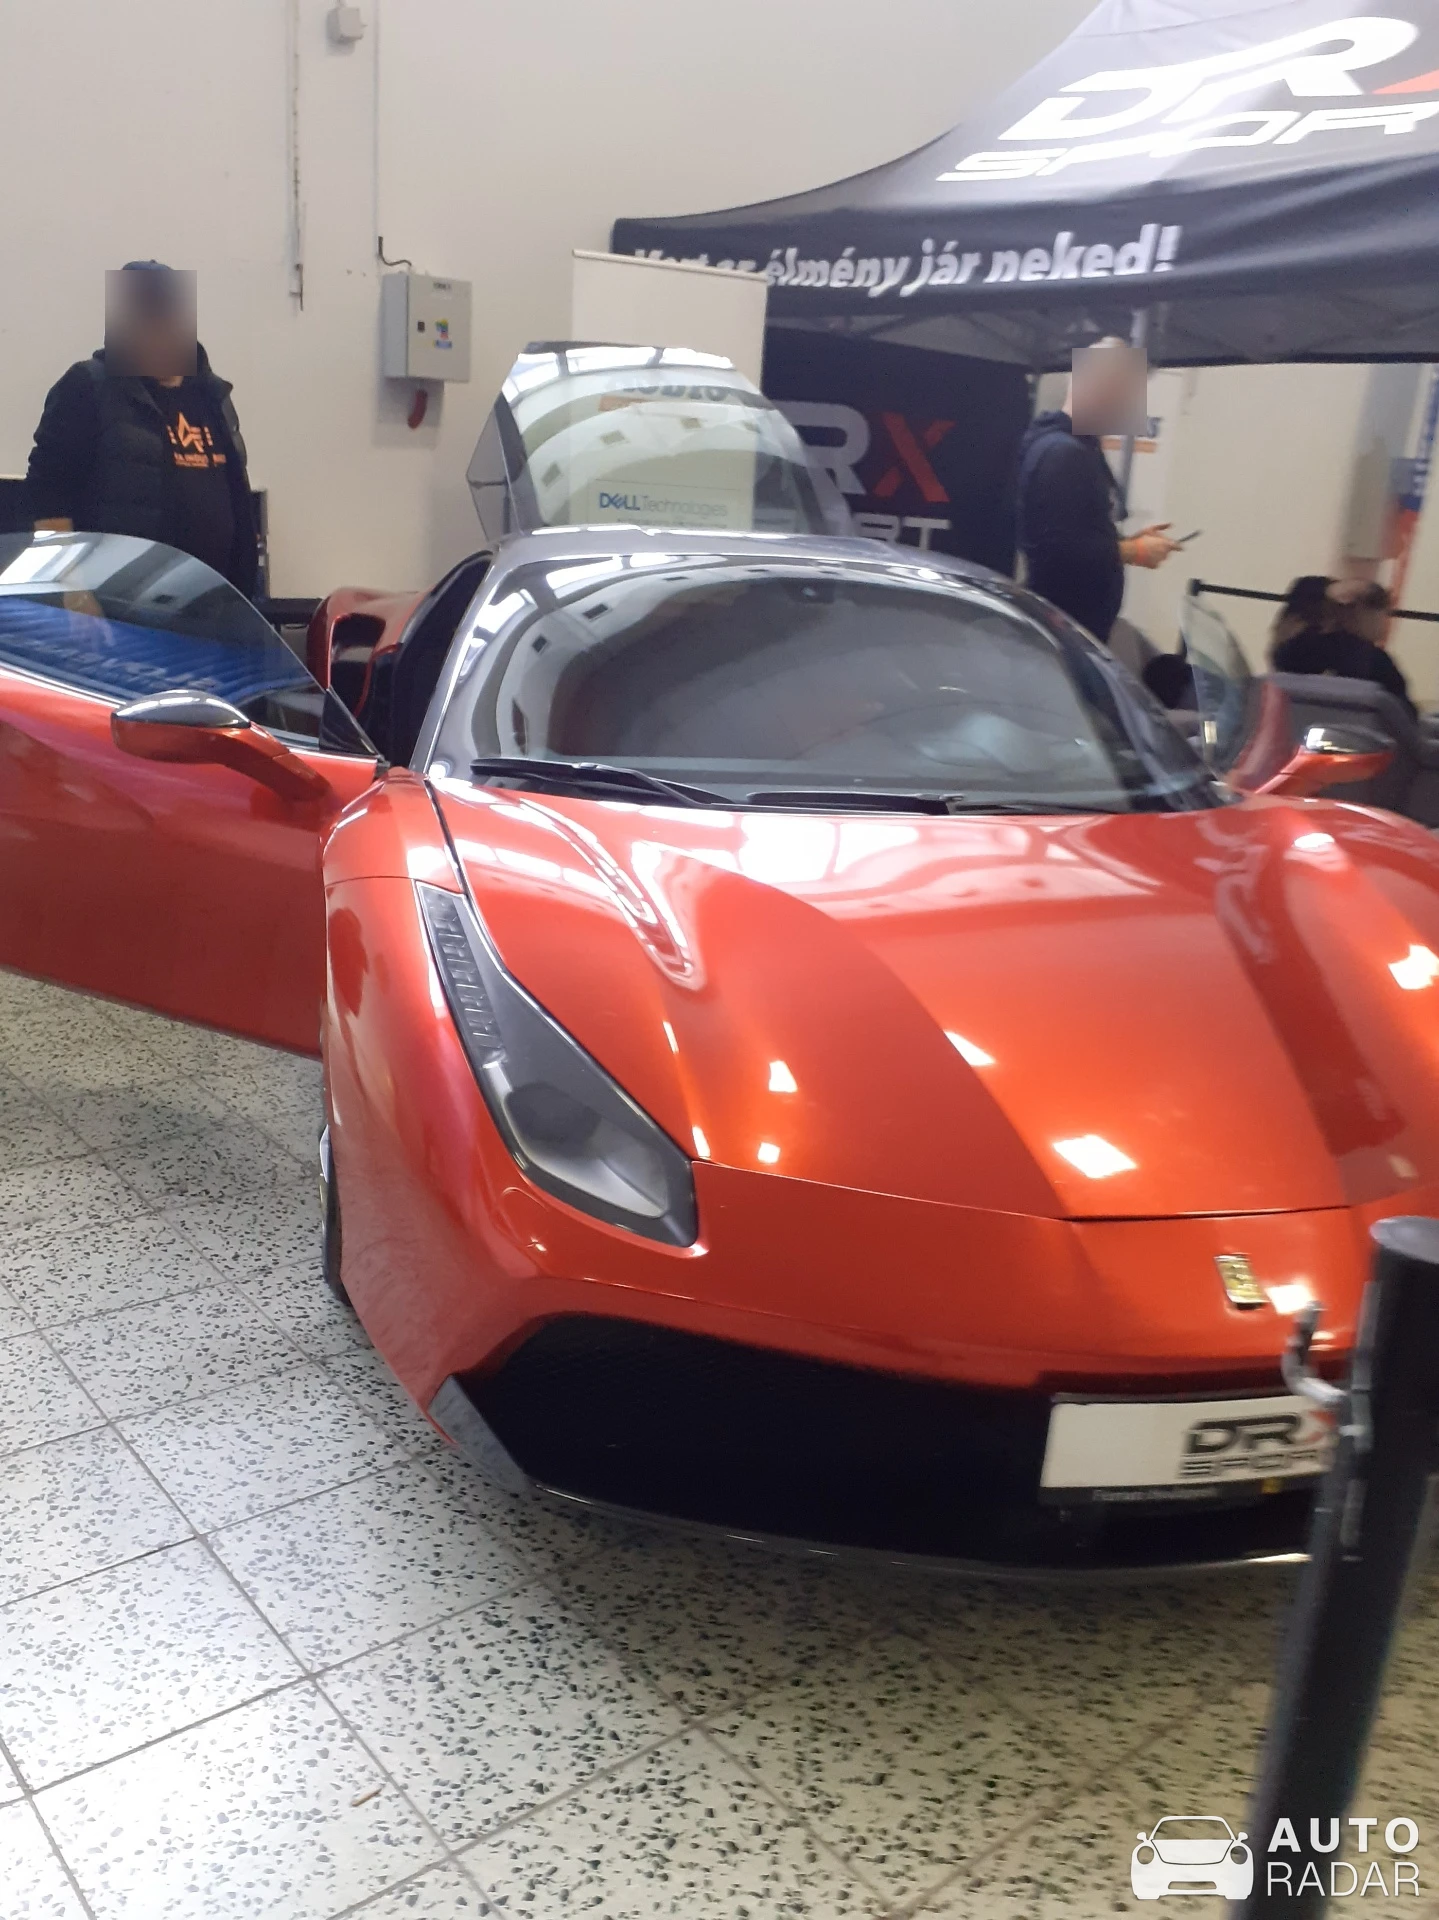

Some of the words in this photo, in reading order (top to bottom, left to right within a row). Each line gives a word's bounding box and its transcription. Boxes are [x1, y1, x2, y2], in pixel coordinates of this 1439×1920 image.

[766, 246, 911, 298] élmény
[899, 238, 981, 298] jár
[982, 223, 1183, 284] neked!
[599, 492, 641, 511] DELL
[642, 495, 729, 518] Technologies
